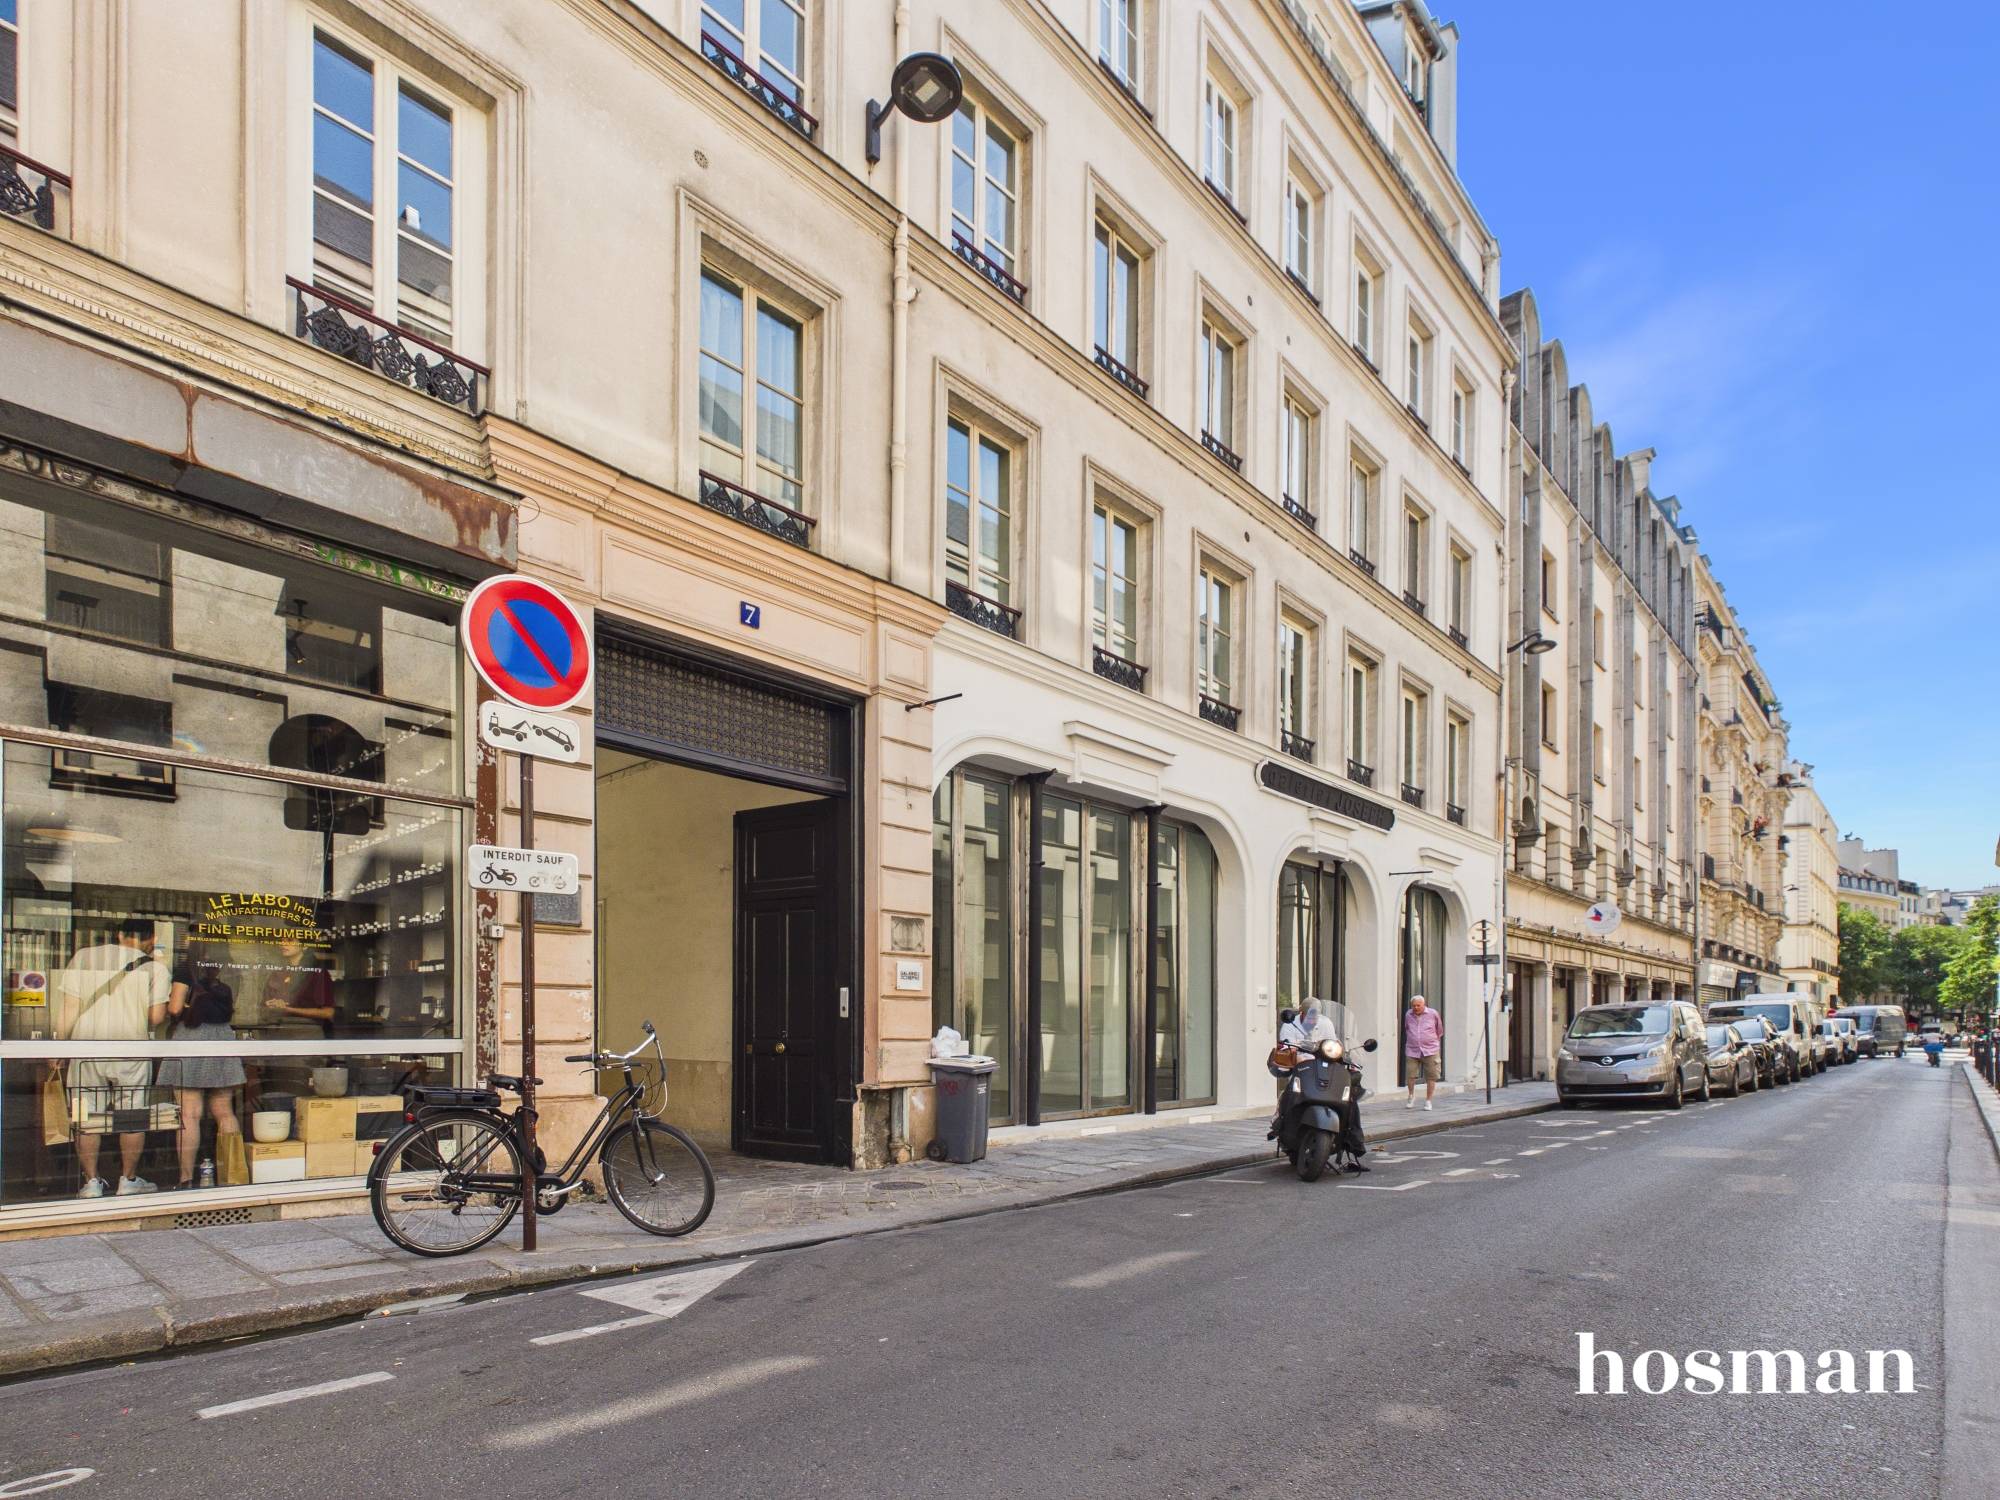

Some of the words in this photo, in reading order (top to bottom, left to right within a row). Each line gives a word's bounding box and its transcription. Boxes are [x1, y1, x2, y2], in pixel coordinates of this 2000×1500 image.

[745, 604, 756, 624] 7
[483, 850, 532, 862] INTERDIT
[537, 855, 564, 865] SAUF
[208, 894, 234, 910] LE
[239, 892, 291, 908] LABO
[293, 902, 315, 918] Inc.
[205, 907, 301, 922] MANUFACTURERS
[302, 918, 317, 928] OF
[198, 923, 231, 935] FINE
[236, 925, 322, 940] PERFUMERY
[196, 961, 224, 969] Twenty
[286, 965, 322, 973] Perfumery
